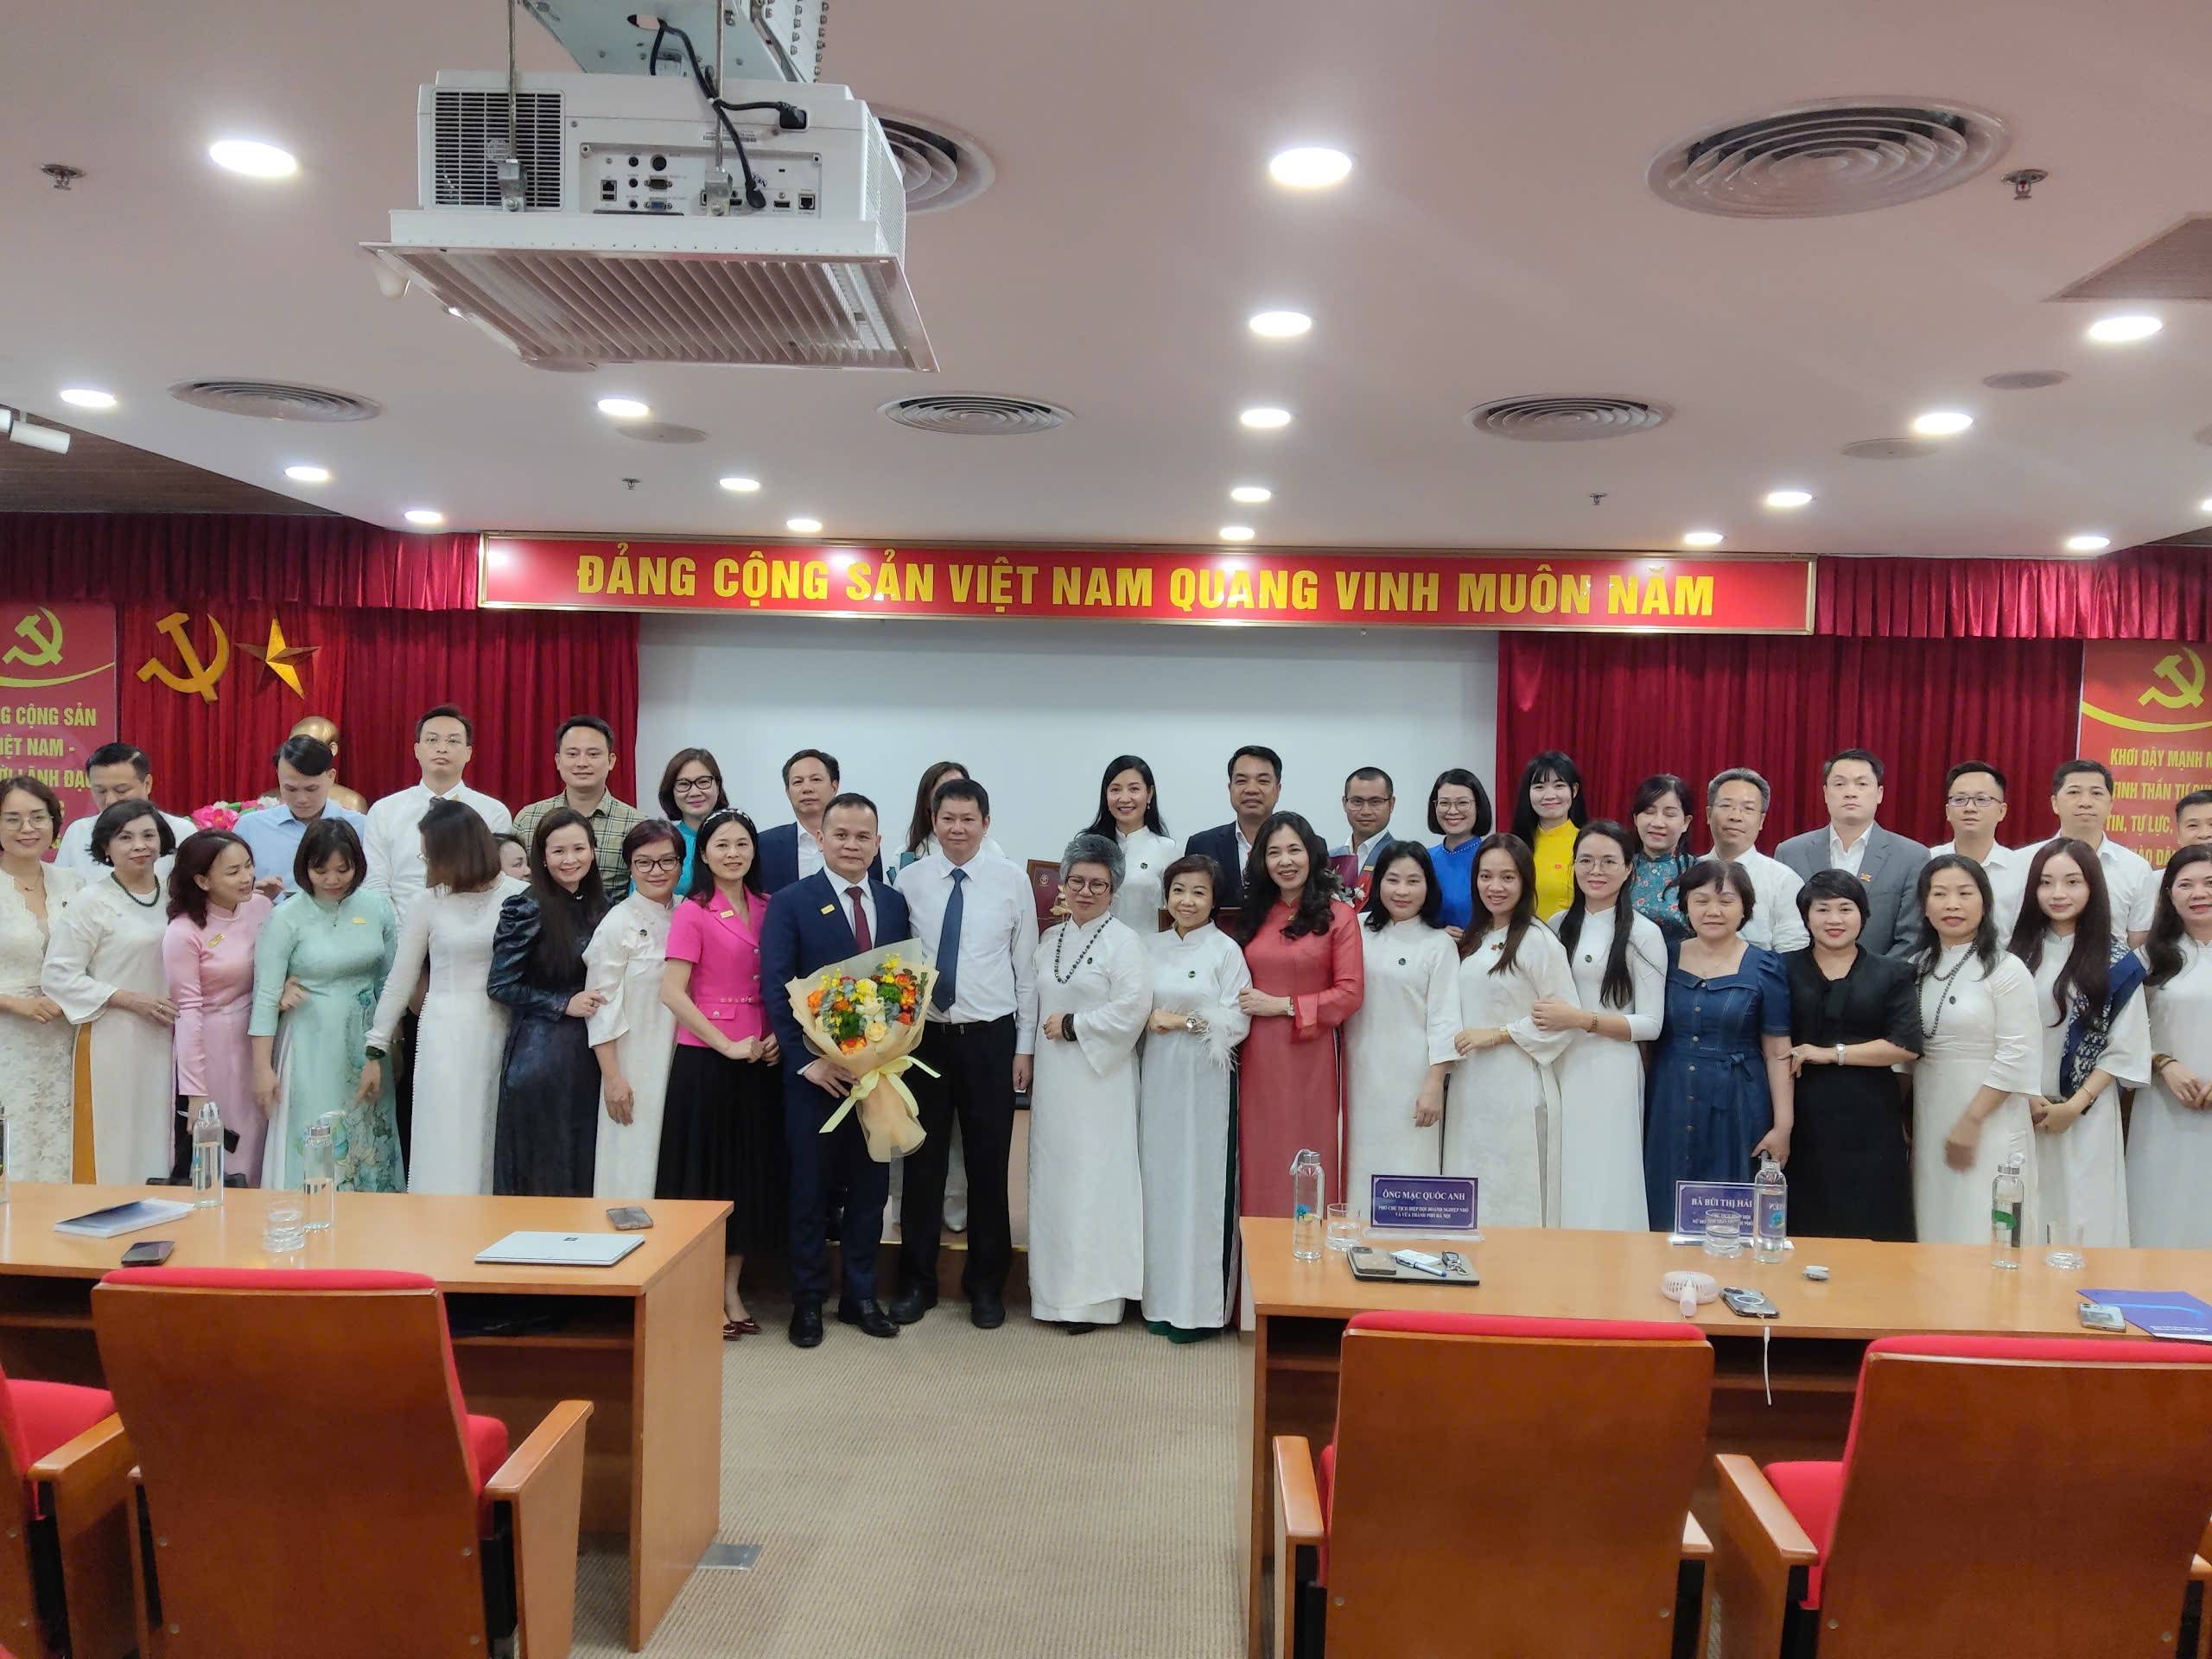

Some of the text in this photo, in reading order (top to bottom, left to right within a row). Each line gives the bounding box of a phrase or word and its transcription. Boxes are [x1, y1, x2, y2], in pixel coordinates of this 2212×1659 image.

[577, 543, 1714, 615] ĐẢNG CỘNG SẢN VIỆT NAM QUANG VINH MUÔN NĂM
[16, 702, 59, 729] CỘNG
[63, 702, 97, 726] SẢN
[0, 734, 22, 759] IỆT
[27, 737, 64, 757] NAM
[2110, 747, 2139, 766] KHƠI
[2142, 747, 2164, 771] DẬY
[2167, 750, 2203, 771] MẠNH
[17, 766, 60, 788] ÃNH
[2157, 845, 2176, 868] DÂ
[1382, 1189, 1401, 1198] ÔNG
[1402, 1192, 1421, 1201] MẠC
[1422, 1191, 1446, 1201] QUỐC
[1691, 1197, 1703, 1206] BÀ
[1705, 1197, 1719, 1206] BÙI
[1720, 1198, 1735, 1208] THỊ
